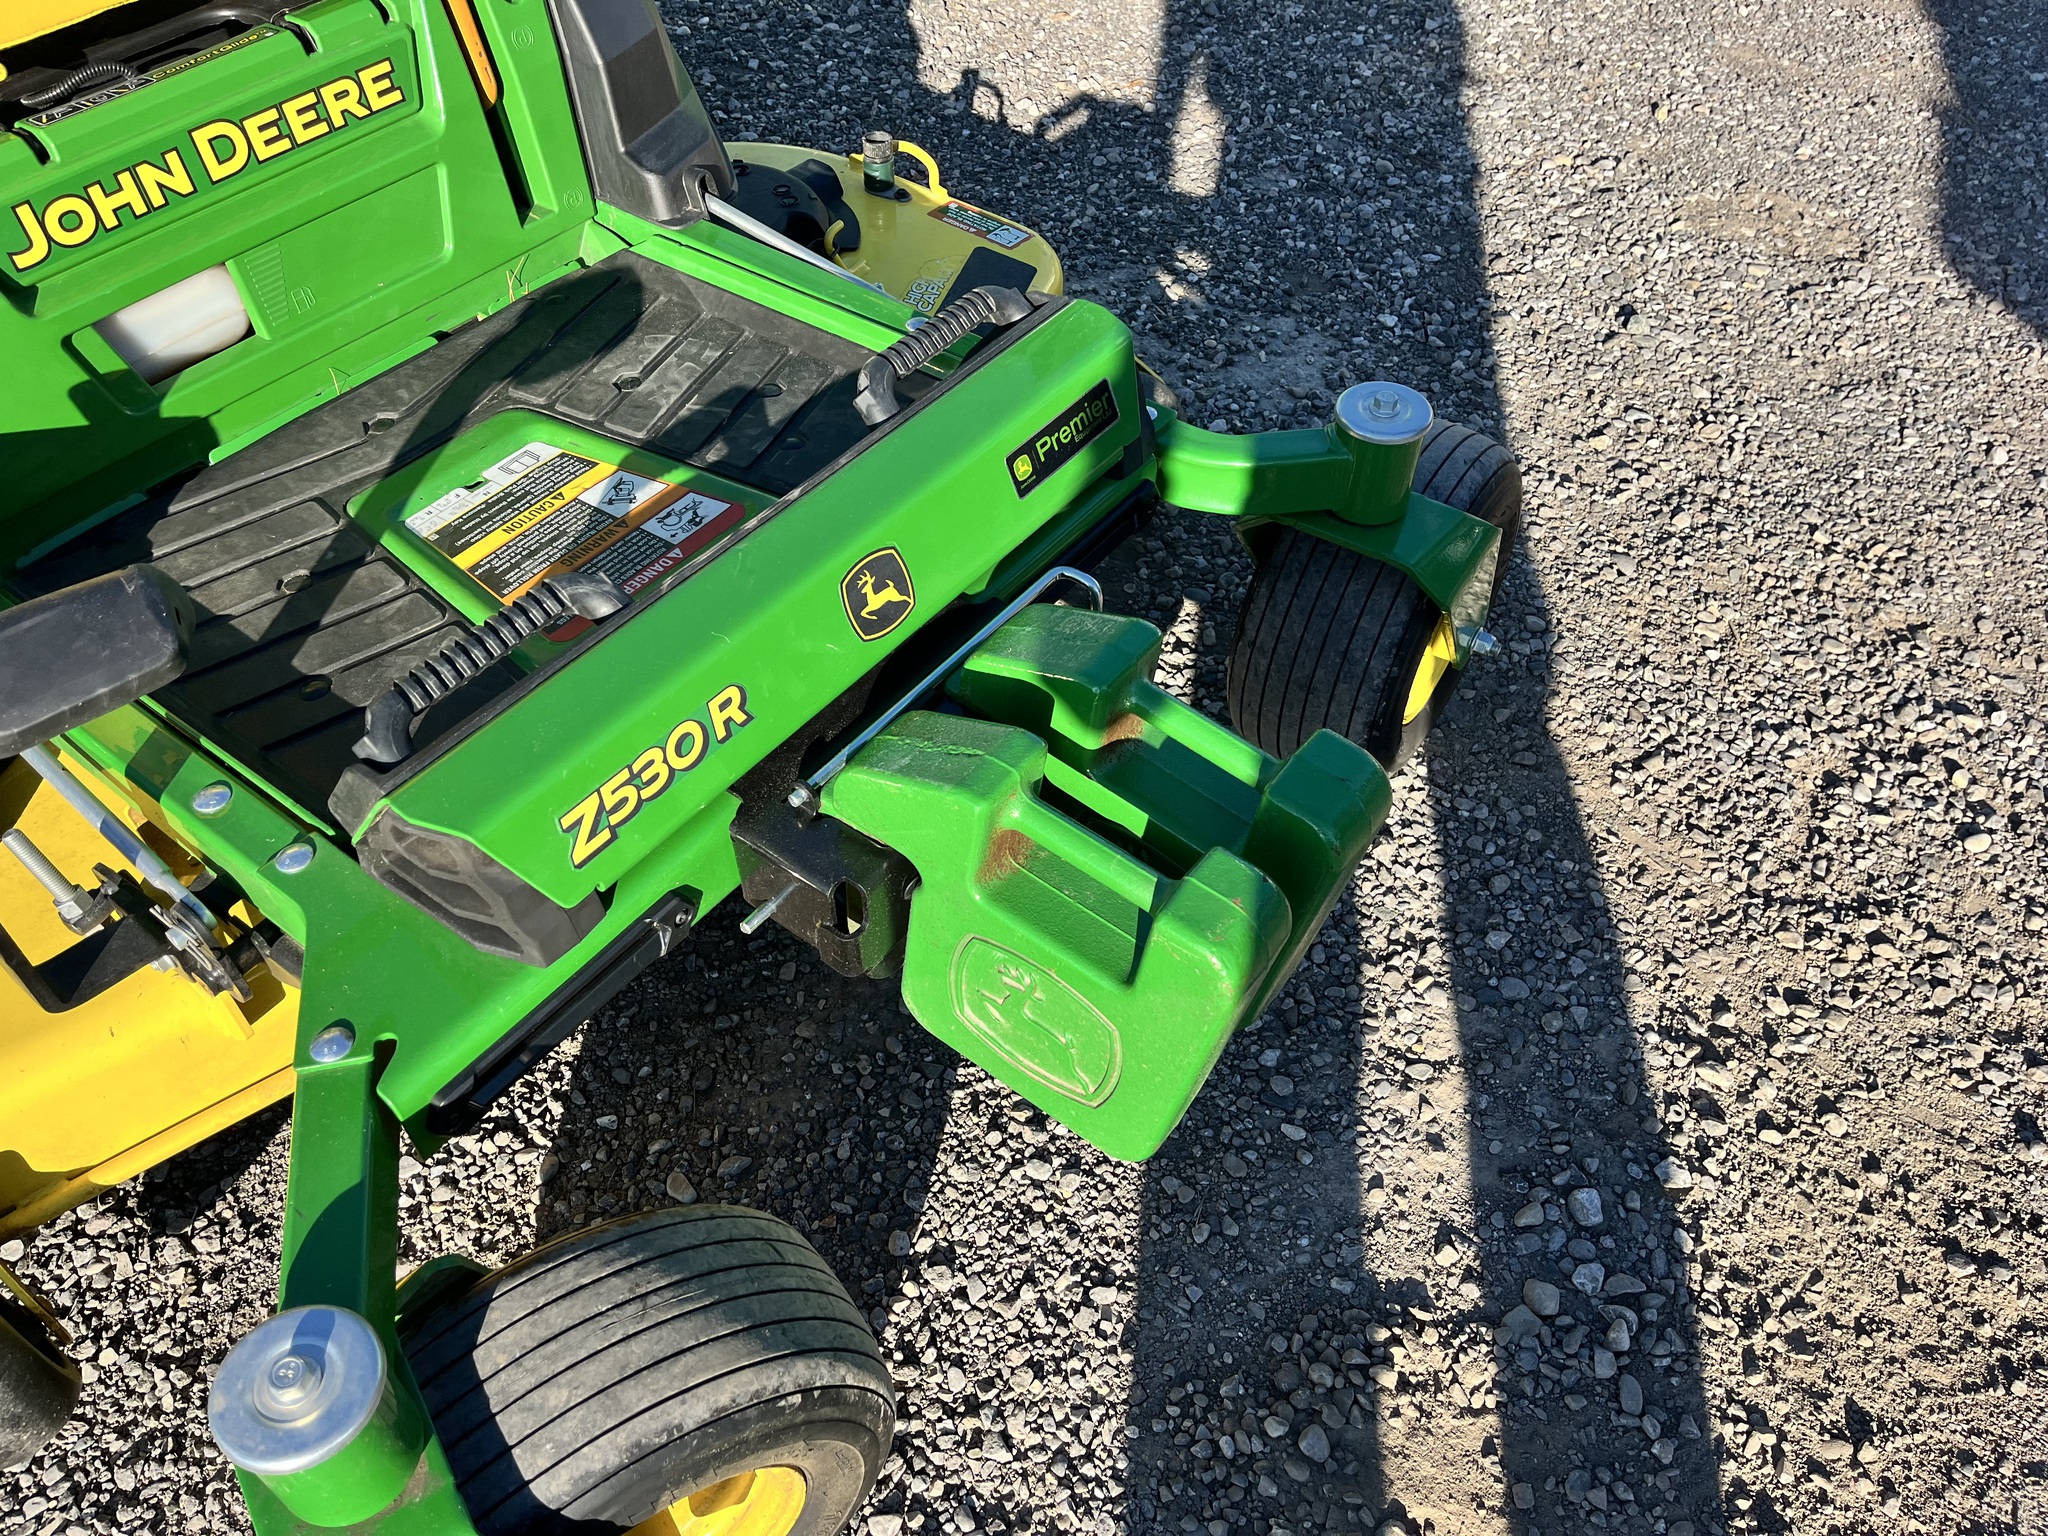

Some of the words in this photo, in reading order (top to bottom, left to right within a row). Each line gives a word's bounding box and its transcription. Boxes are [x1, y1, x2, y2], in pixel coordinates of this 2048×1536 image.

[8, 147, 196, 271] JOHN
[187, 57, 403, 183] DEERE
[1035, 391, 1109, 463] Premier
[500, 499, 557, 535] CAUTION
[593, 517, 615, 531] AVOID
[565, 541, 579, 550] OR
[575, 528, 598, 543] INJURY
[546, 547, 569, 563] DEATH
[558, 527, 620, 568] WARNING
[530, 560, 551, 574] FROM
[500, 572, 534, 595] ROLLOVER
[559, 719, 709, 869] Z530
[707, 683, 755, 744] R
